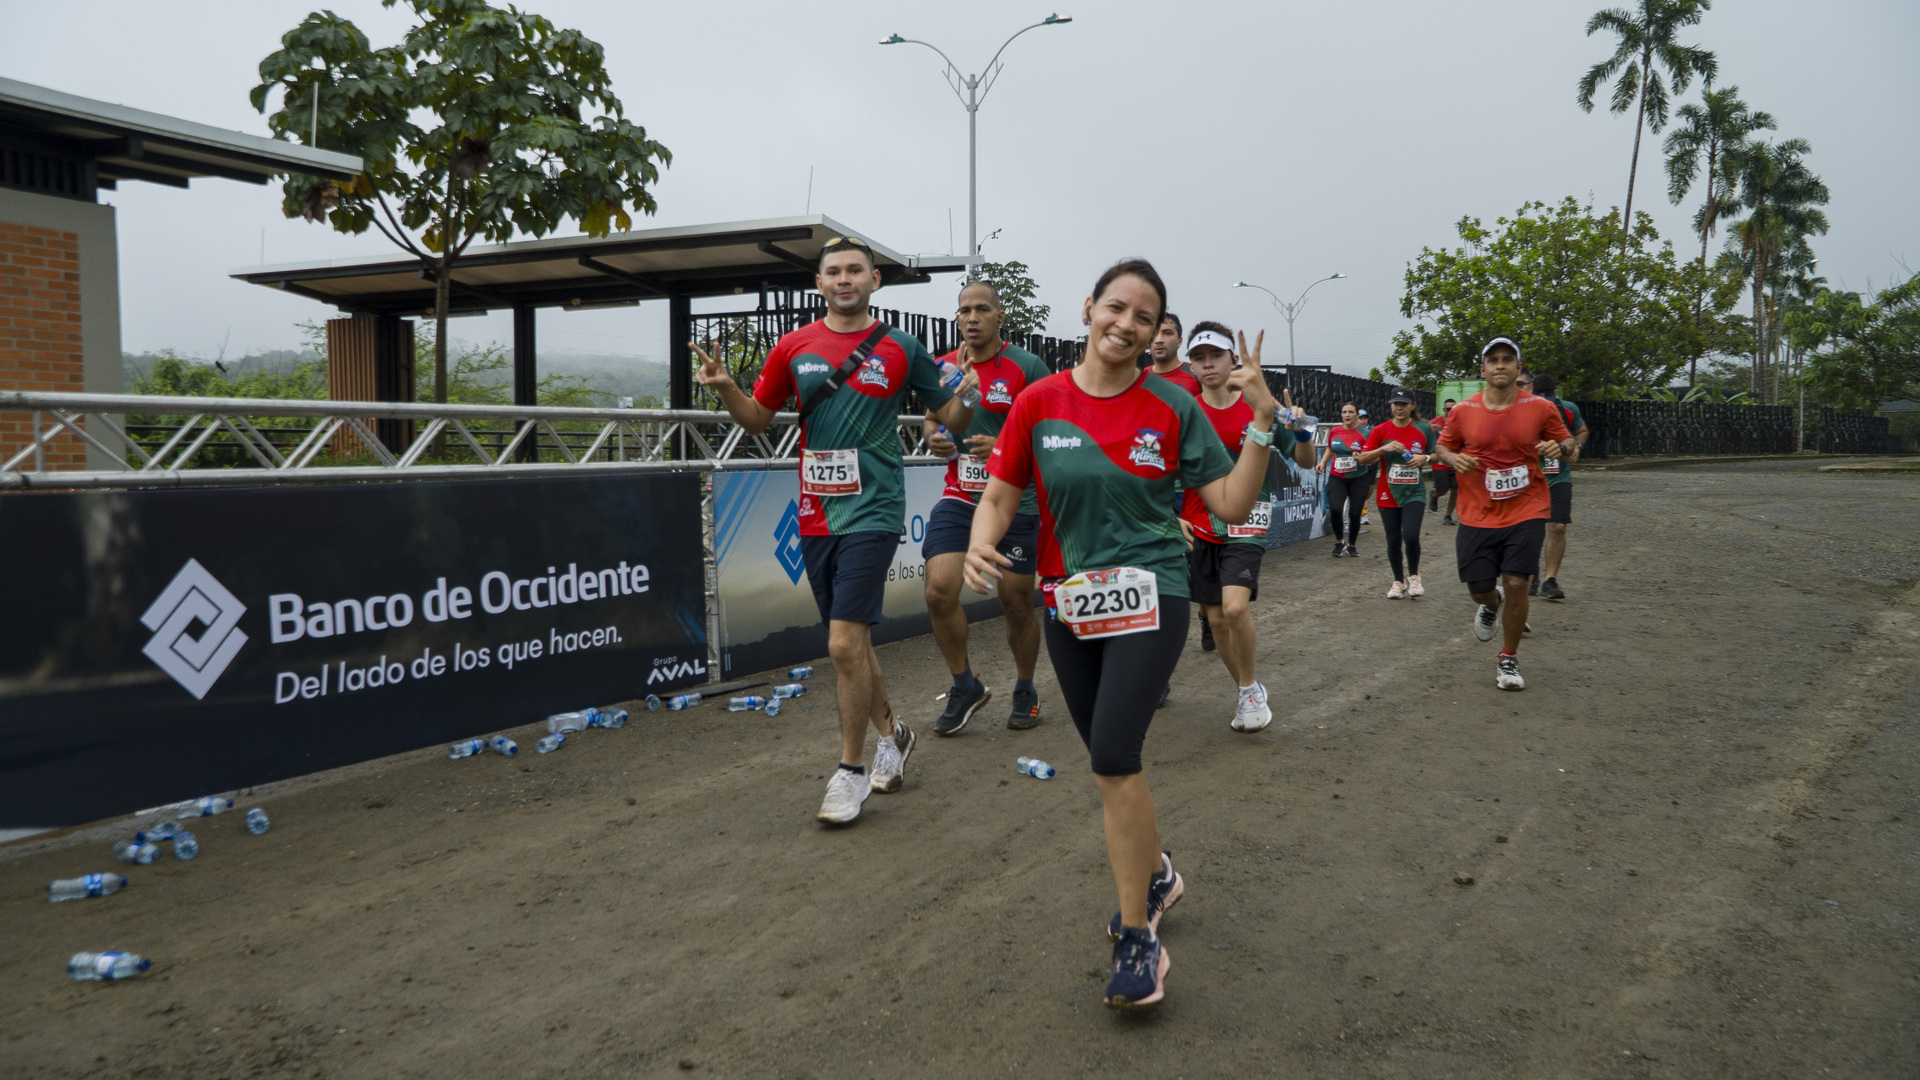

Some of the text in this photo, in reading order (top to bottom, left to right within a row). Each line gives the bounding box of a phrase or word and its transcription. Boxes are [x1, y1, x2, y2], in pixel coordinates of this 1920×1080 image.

[1128, 449, 1165, 467] Muñeca
[808, 465, 847, 481] 1275
[965, 466, 989, 480] 590
[1395, 470, 1414, 478] 1402
[1496, 477, 1518, 490] 810
[1283, 486, 1292, 502] TU
[899, 561, 915, 580] los
[269, 561, 650, 644] Banco de Occidente
[1074, 587, 1141, 618] 2230
[275, 624, 623, 704] Del lado de los que hacen.
[653, 656, 677, 666] Grupo
[647, 659, 706, 686] AVAL
